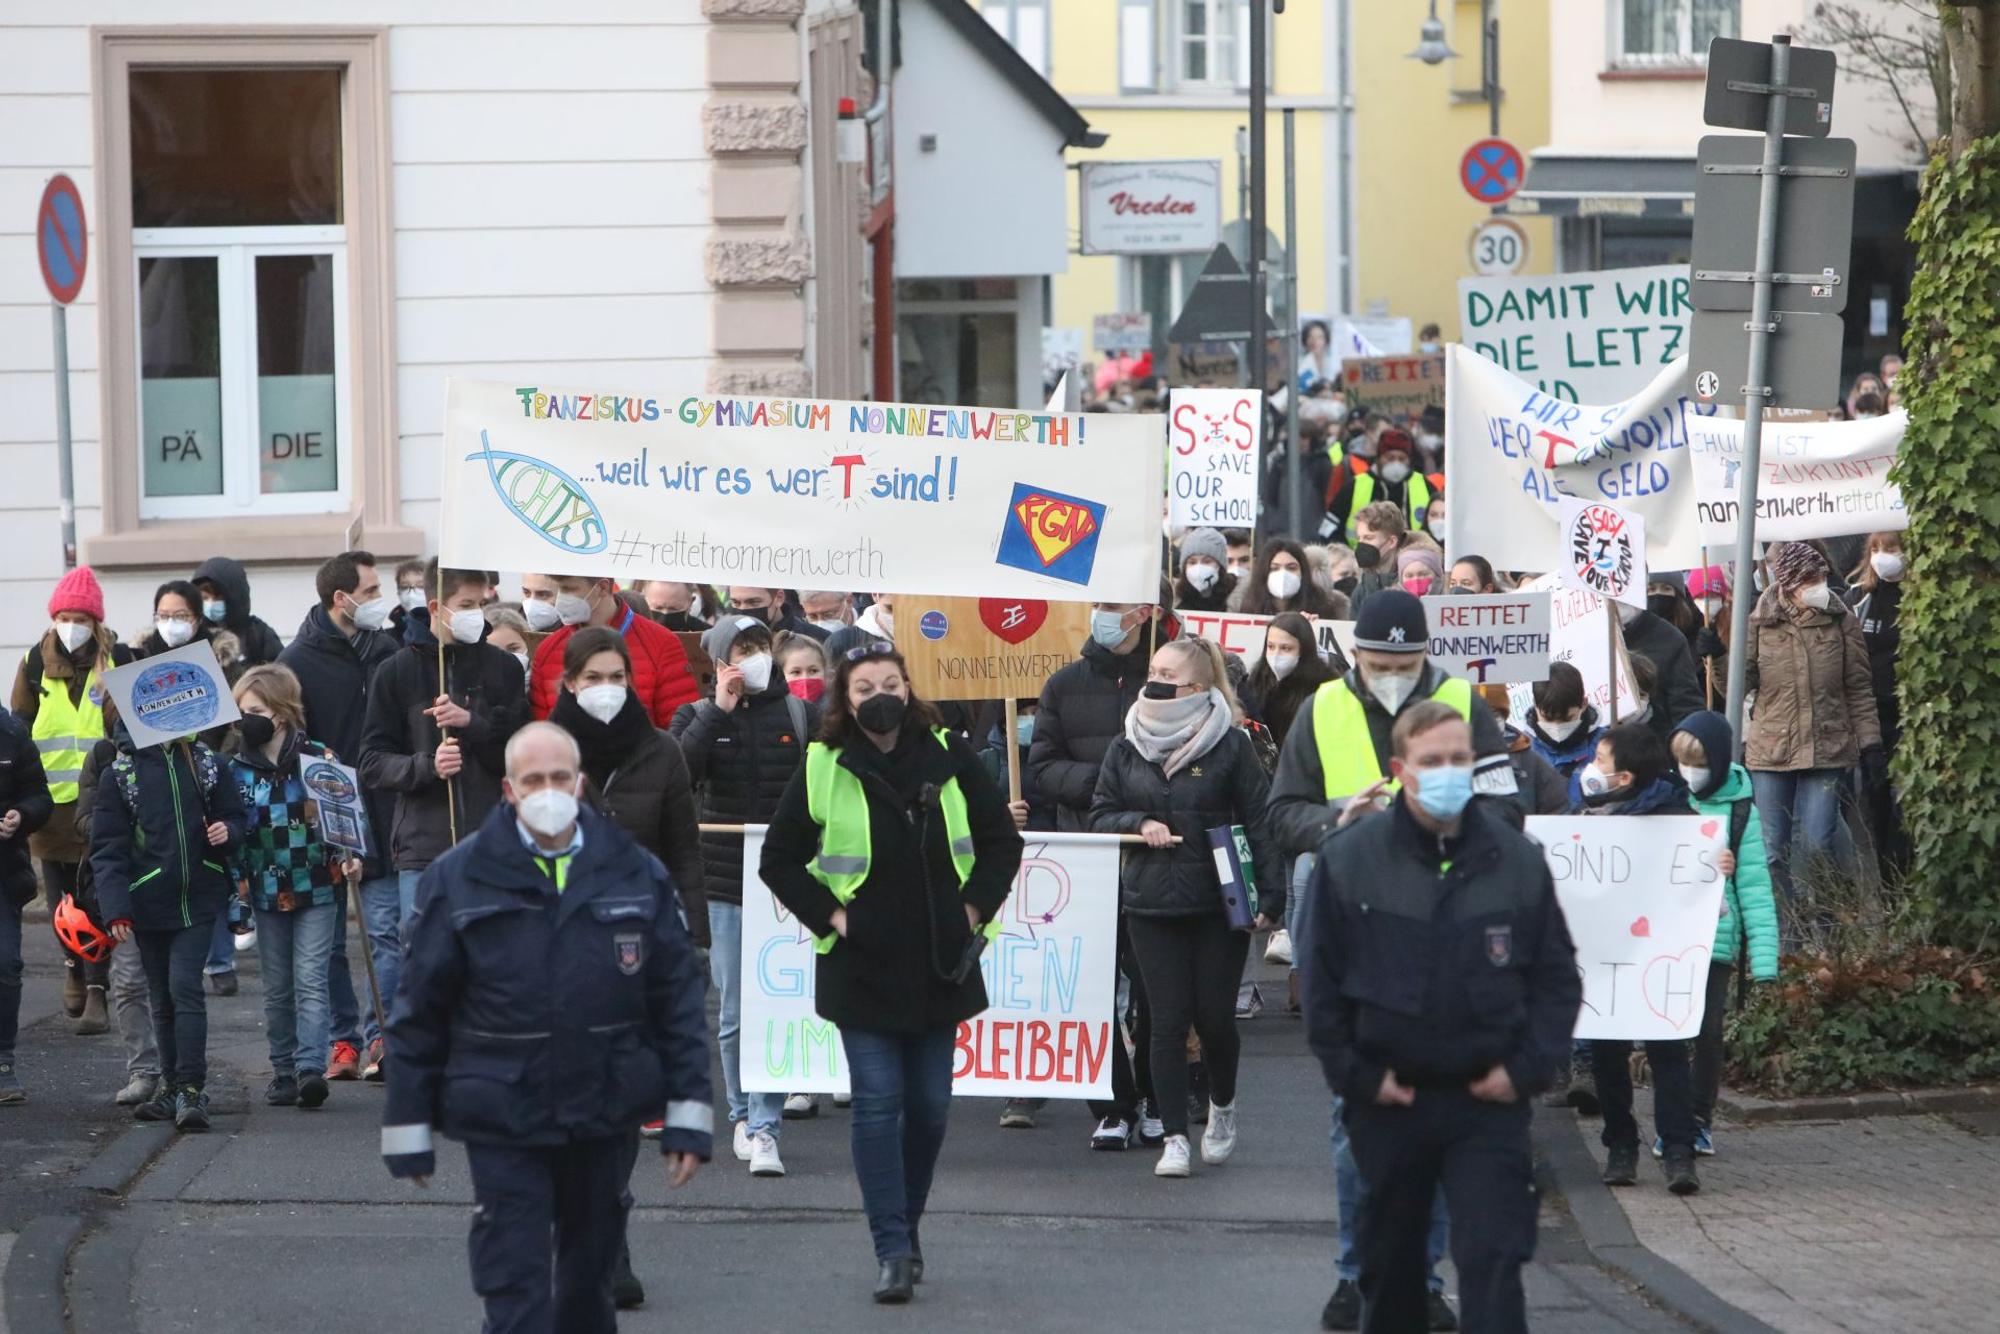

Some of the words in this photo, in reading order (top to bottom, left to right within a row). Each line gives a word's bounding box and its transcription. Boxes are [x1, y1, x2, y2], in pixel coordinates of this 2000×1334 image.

[1108, 191, 1197, 216] Vreden
[1479, 235, 1518, 266] 30
[1467, 284, 1595, 327] DAMIT
[1615, 277, 1696, 317] WIR
[1566, 325, 1684, 368] LETZ
[1520, 391, 1581, 432] WIR
[160, 430, 203, 462] PÄ
[271, 431, 323, 459] DIE
[1776, 435, 1814, 456] IST
[659, 460, 708, 493] wir
[715, 467, 752, 496] es
[1206, 453, 1253, 475] SAVE
[1597, 460, 1670, 500] GELD
[1176, 471, 1223, 499] OUR
[1190, 498, 1253, 521] SCHOOL
[1440, 604, 1531, 628] RETTET
[1551, 842, 1632, 883] SIND
[1670, 843, 1719, 884] ES
[764, 1017, 838, 1079] UM
[952, 1019, 1109, 1084] BLEIBEN
